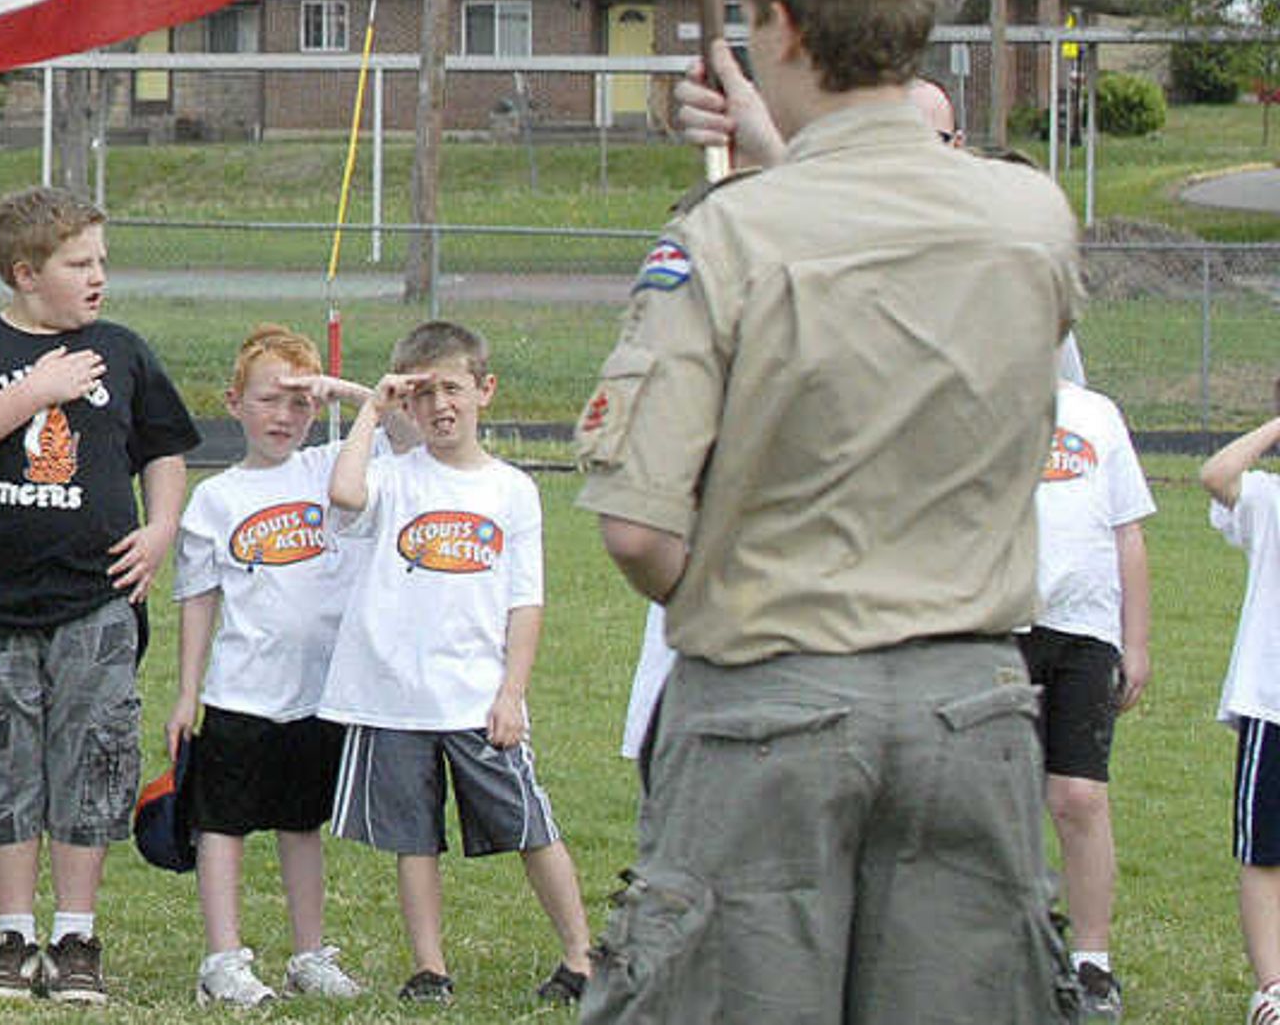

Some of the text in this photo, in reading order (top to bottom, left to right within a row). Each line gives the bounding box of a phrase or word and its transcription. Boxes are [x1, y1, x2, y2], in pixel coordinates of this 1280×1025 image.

[238, 511, 302, 556] SCOUTS
[276, 527, 326, 551] ACTIO
[407, 521, 473, 552] SCOUTS
